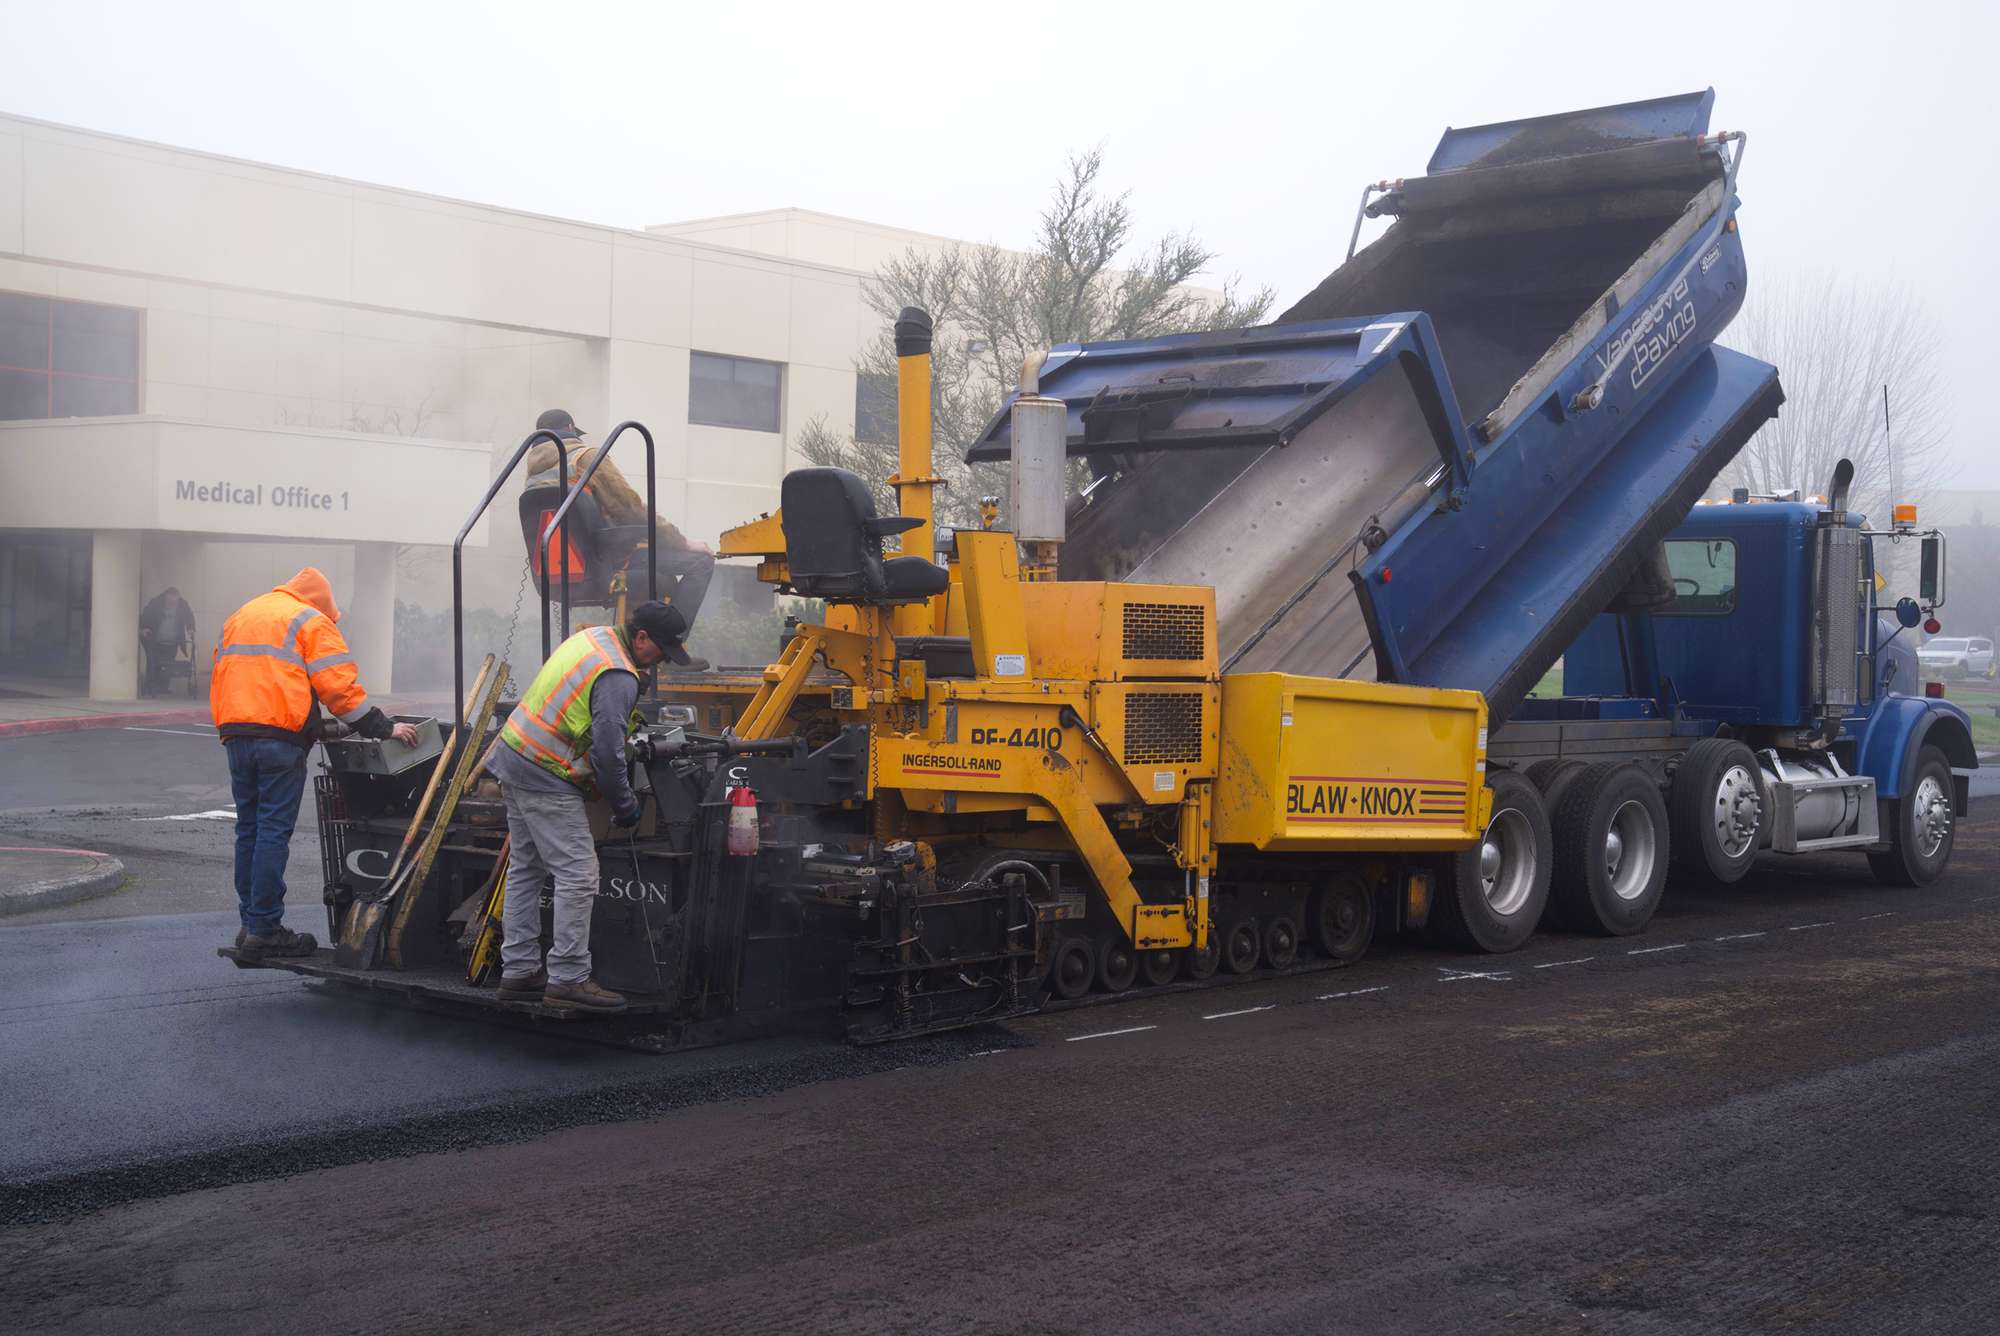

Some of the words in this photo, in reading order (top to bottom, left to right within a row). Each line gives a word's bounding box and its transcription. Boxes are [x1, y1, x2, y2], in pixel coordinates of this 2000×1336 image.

[175, 479, 263, 506] Medical
[271, 486, 333, 511] Office
[341, 491, 350, 511] 1
[971, 727, 1063, 752] DF-4410
[902, 753, 1002, 771] INGERSOLL-RAND
[1286, 784, 1348, 814] BLAW
[1360, 786, 1417, 816] KNOX
[346, 848, 391, 880] C
[599, 877, 668, 905] SON
